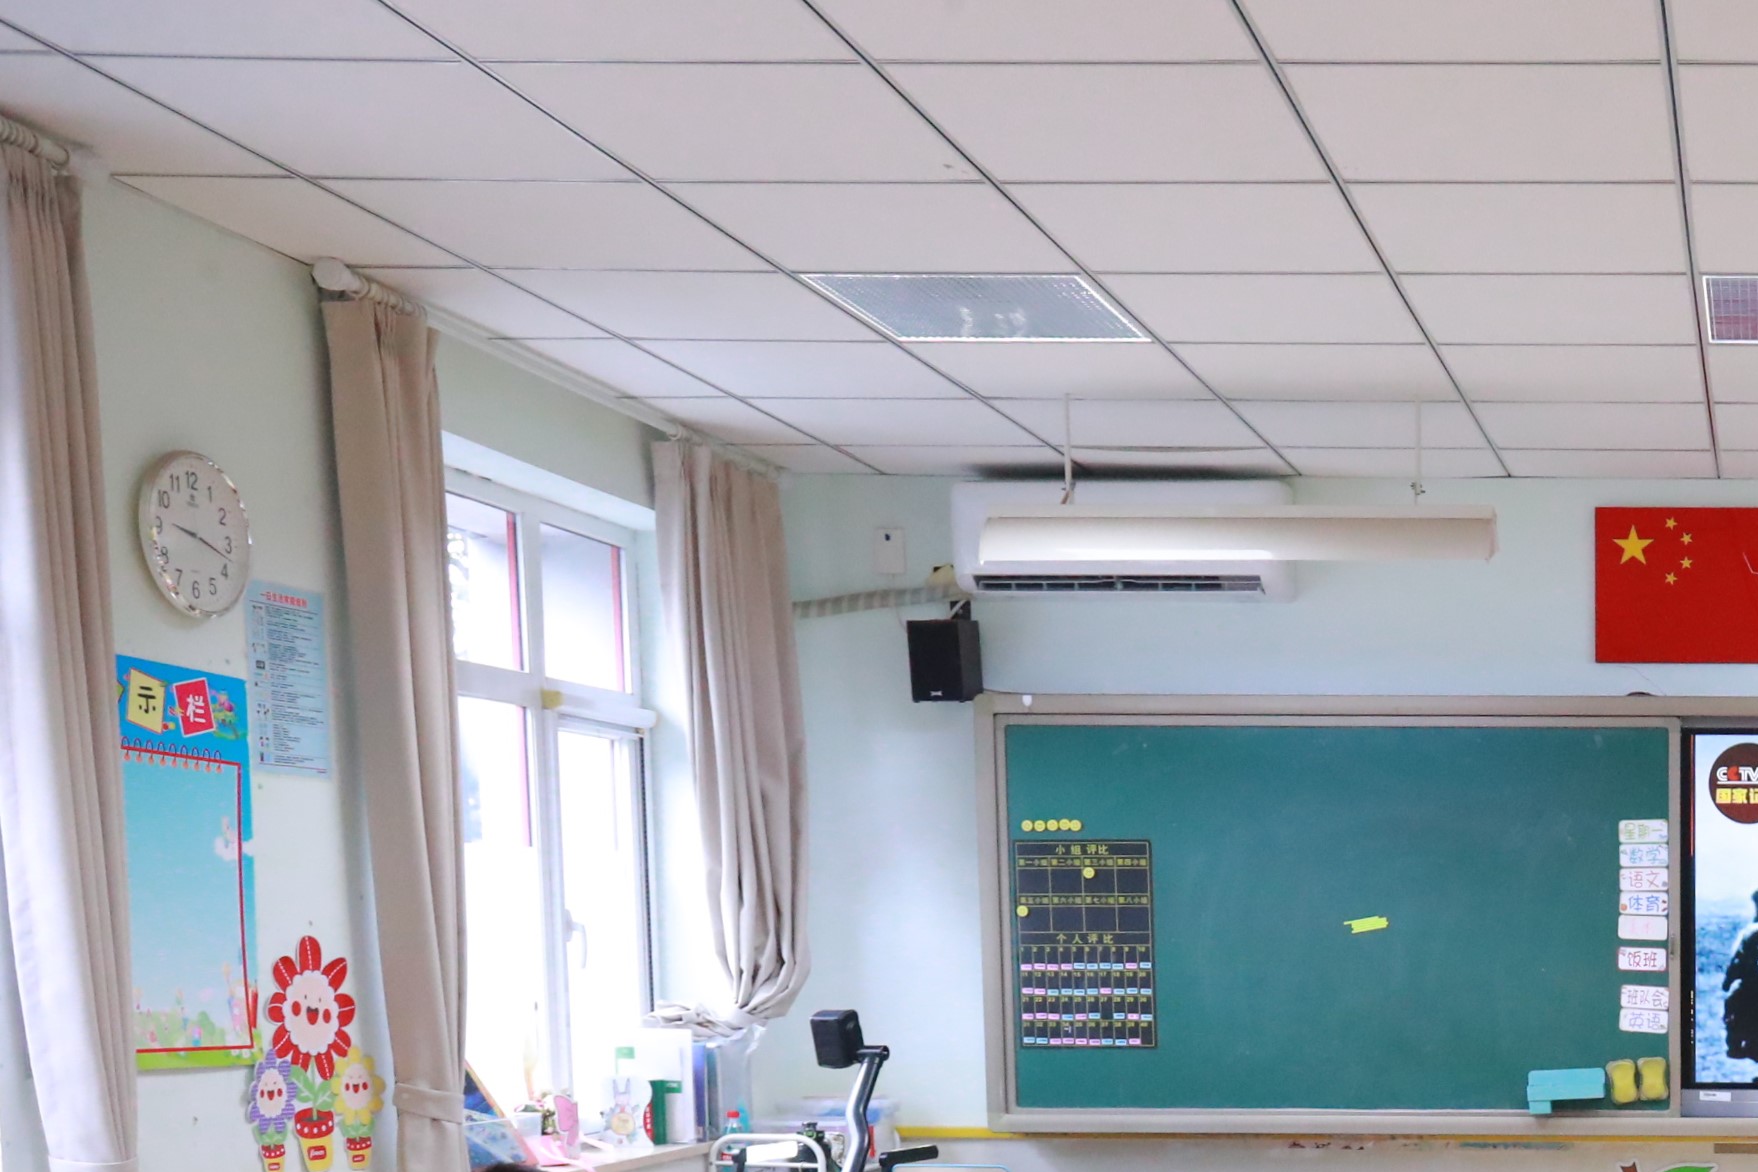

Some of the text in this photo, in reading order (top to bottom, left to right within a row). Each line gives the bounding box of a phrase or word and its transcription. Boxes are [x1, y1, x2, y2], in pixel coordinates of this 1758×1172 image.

[169, 474, 180, 493] 11
[185, 471, 198, 491] 12
[158, 490, 170, 509] 10
[207, 486, 212, 503] 1
[155, 516, 163, 534] 9
[218, 508, 226, 526] 2
[224, 536, 232, 554] 3
[158, 547, 169, 564] 8
[175, 568, 183, 586] 7
[220, 563, 228, 580] 4
[192, 581, 200, 599] 6
[208, 578, 216, 595] 5
[1629, 847, 1661, 865] 数学
[1629, 870, 1660, 889] 语文
[1628, 895, 1660, 912] 体育
[1057, 933, 1113, 943] 个人评比
[1627, 989, 1664, 1007] 班队会
[1629, 1012, 1661, 1030] 英语
